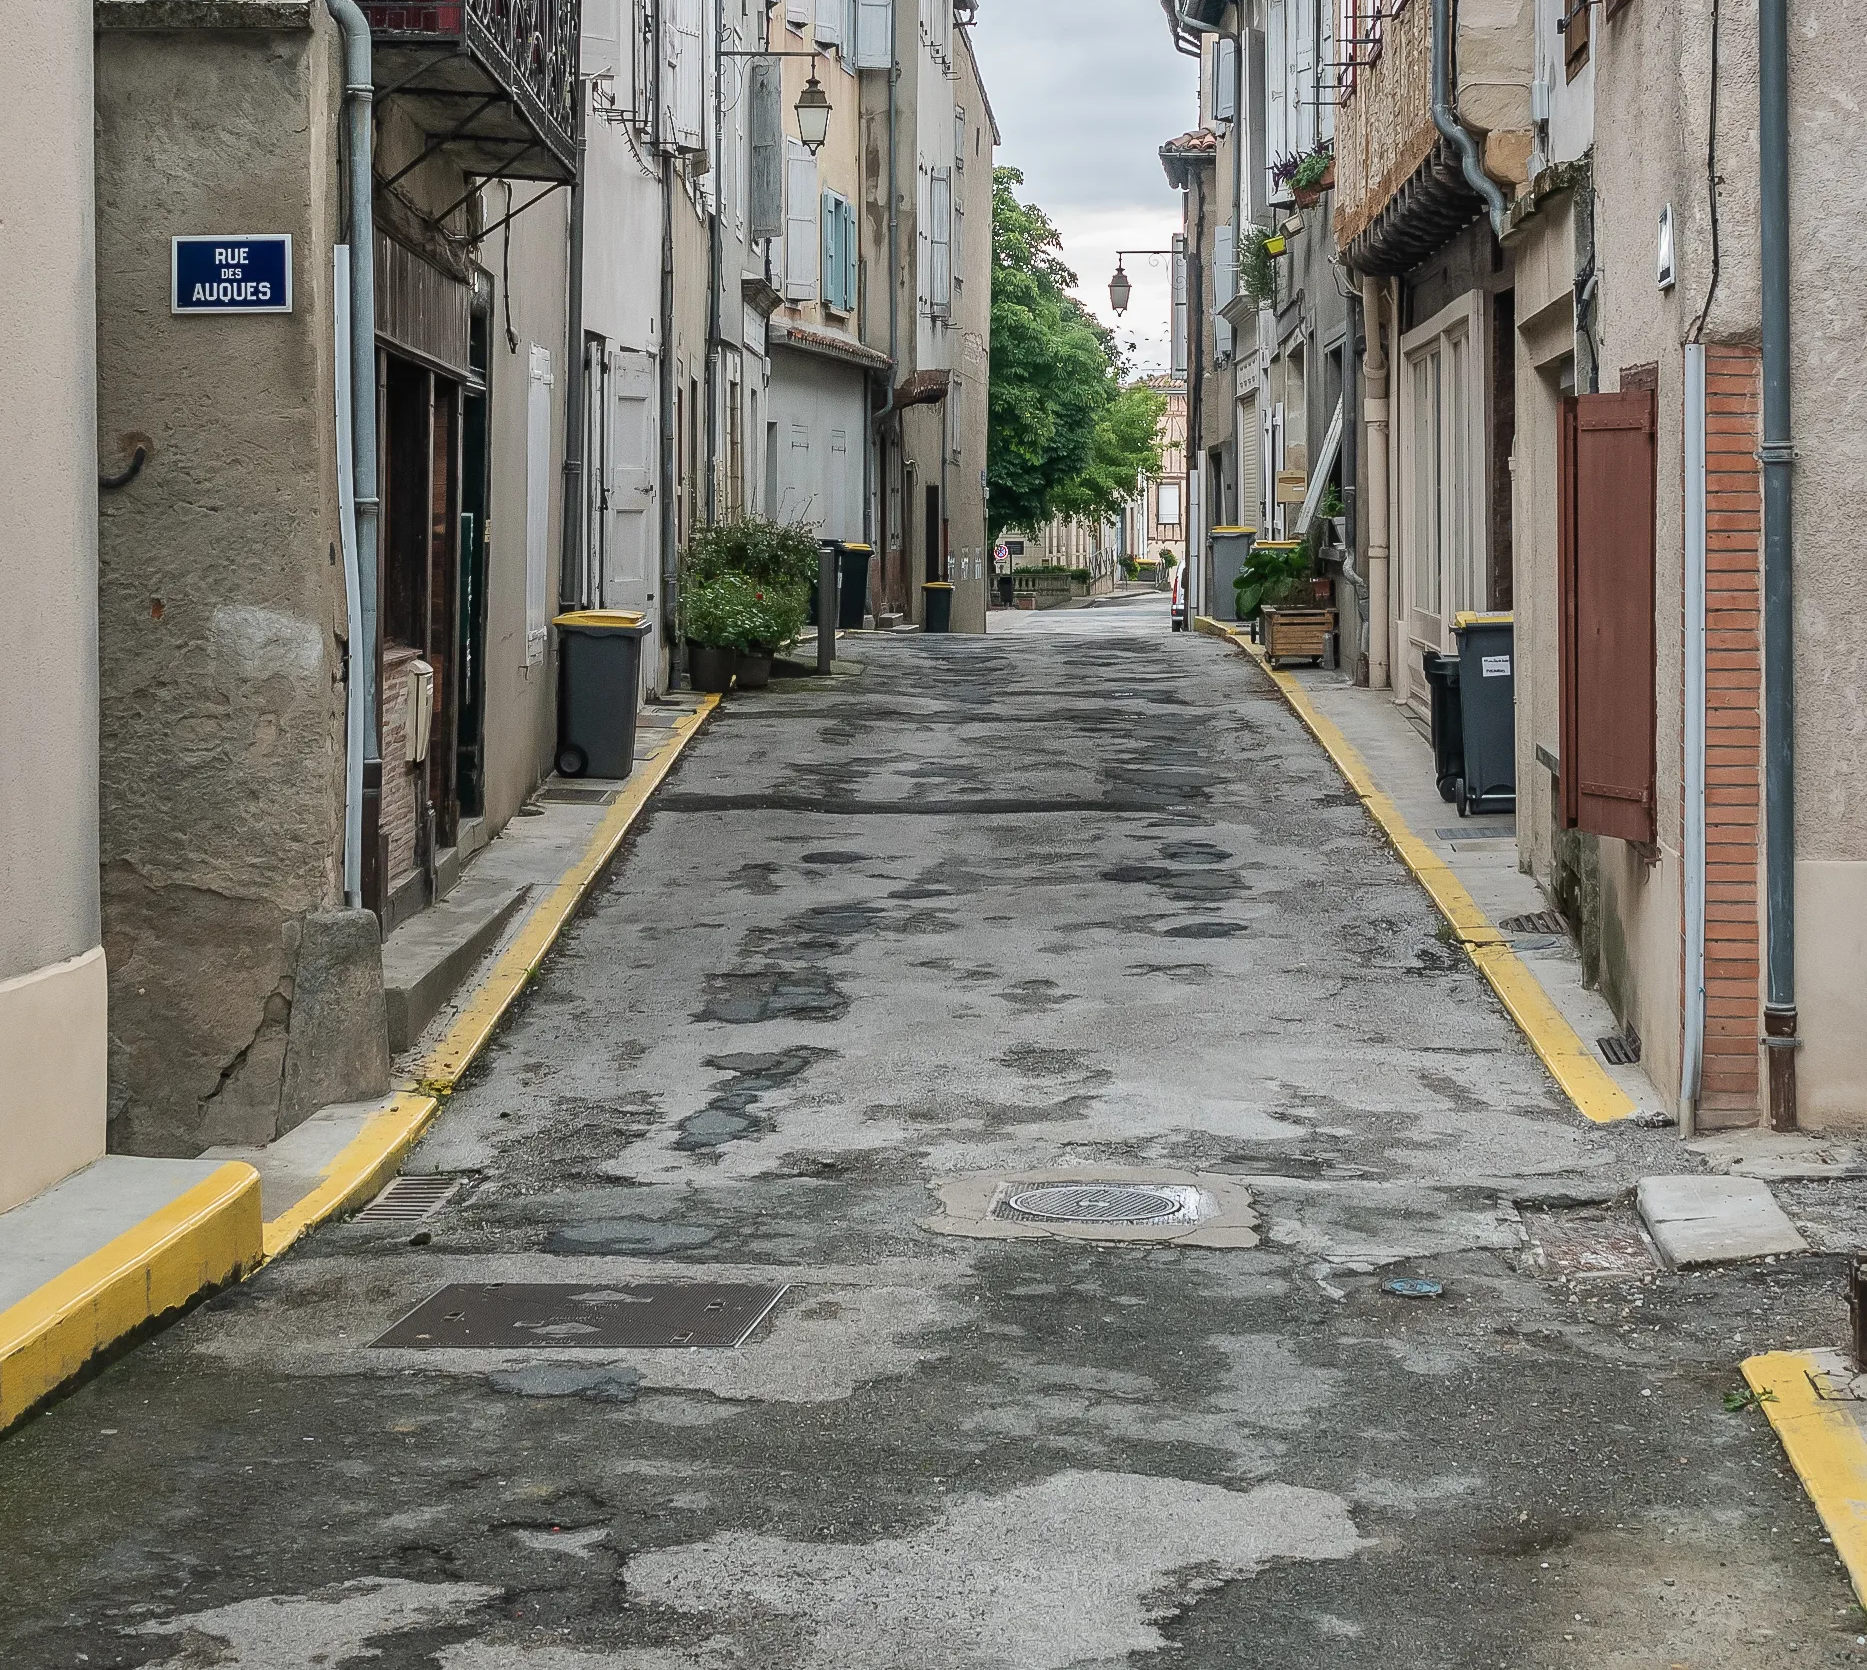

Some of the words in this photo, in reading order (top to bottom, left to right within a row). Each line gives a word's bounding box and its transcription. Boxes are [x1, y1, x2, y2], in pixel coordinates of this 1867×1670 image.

[215, 247, 249, 265] RUE
[221, 268, 242, 279] DES
[192, 281, 271, 303] AUQUES
